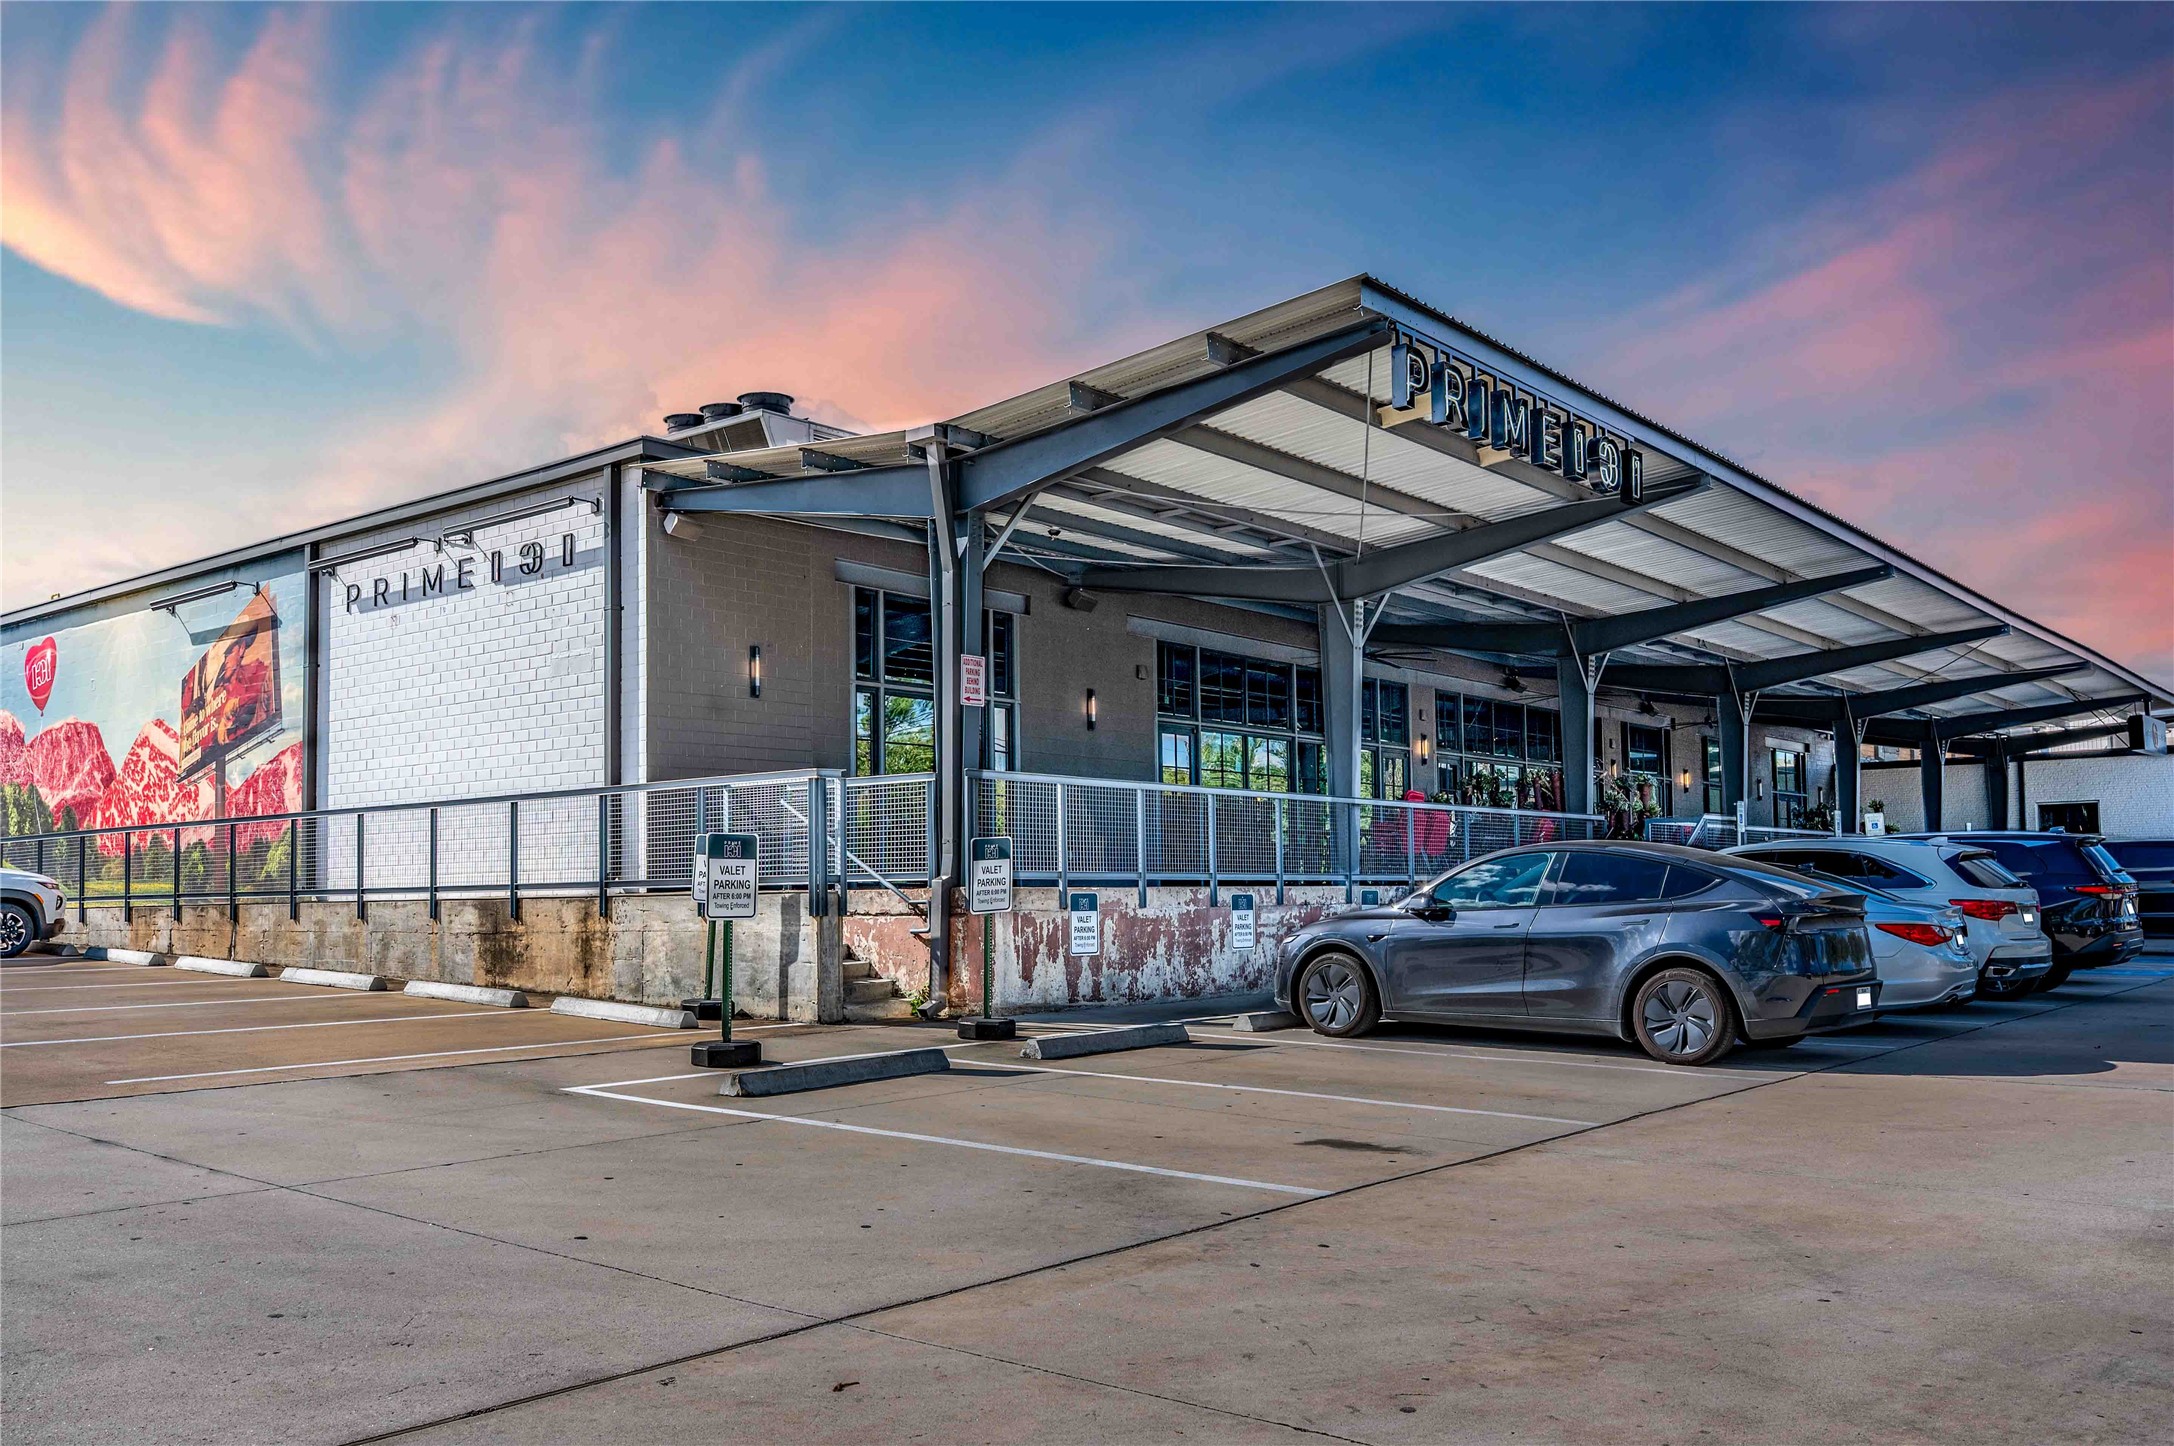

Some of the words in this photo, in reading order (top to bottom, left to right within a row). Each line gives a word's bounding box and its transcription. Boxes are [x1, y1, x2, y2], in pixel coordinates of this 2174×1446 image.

[966, 667, 980, 676] PARKING
[719, 865, 746, 876] VALET
[981, 866, 1002, 874] VALET
[714, 880, 750, 889] PARKING
[977, 877, 1007, 888] PARKING
[976, 889, 990, 897] AFTER
[714, 902, 729, 910] Towing
